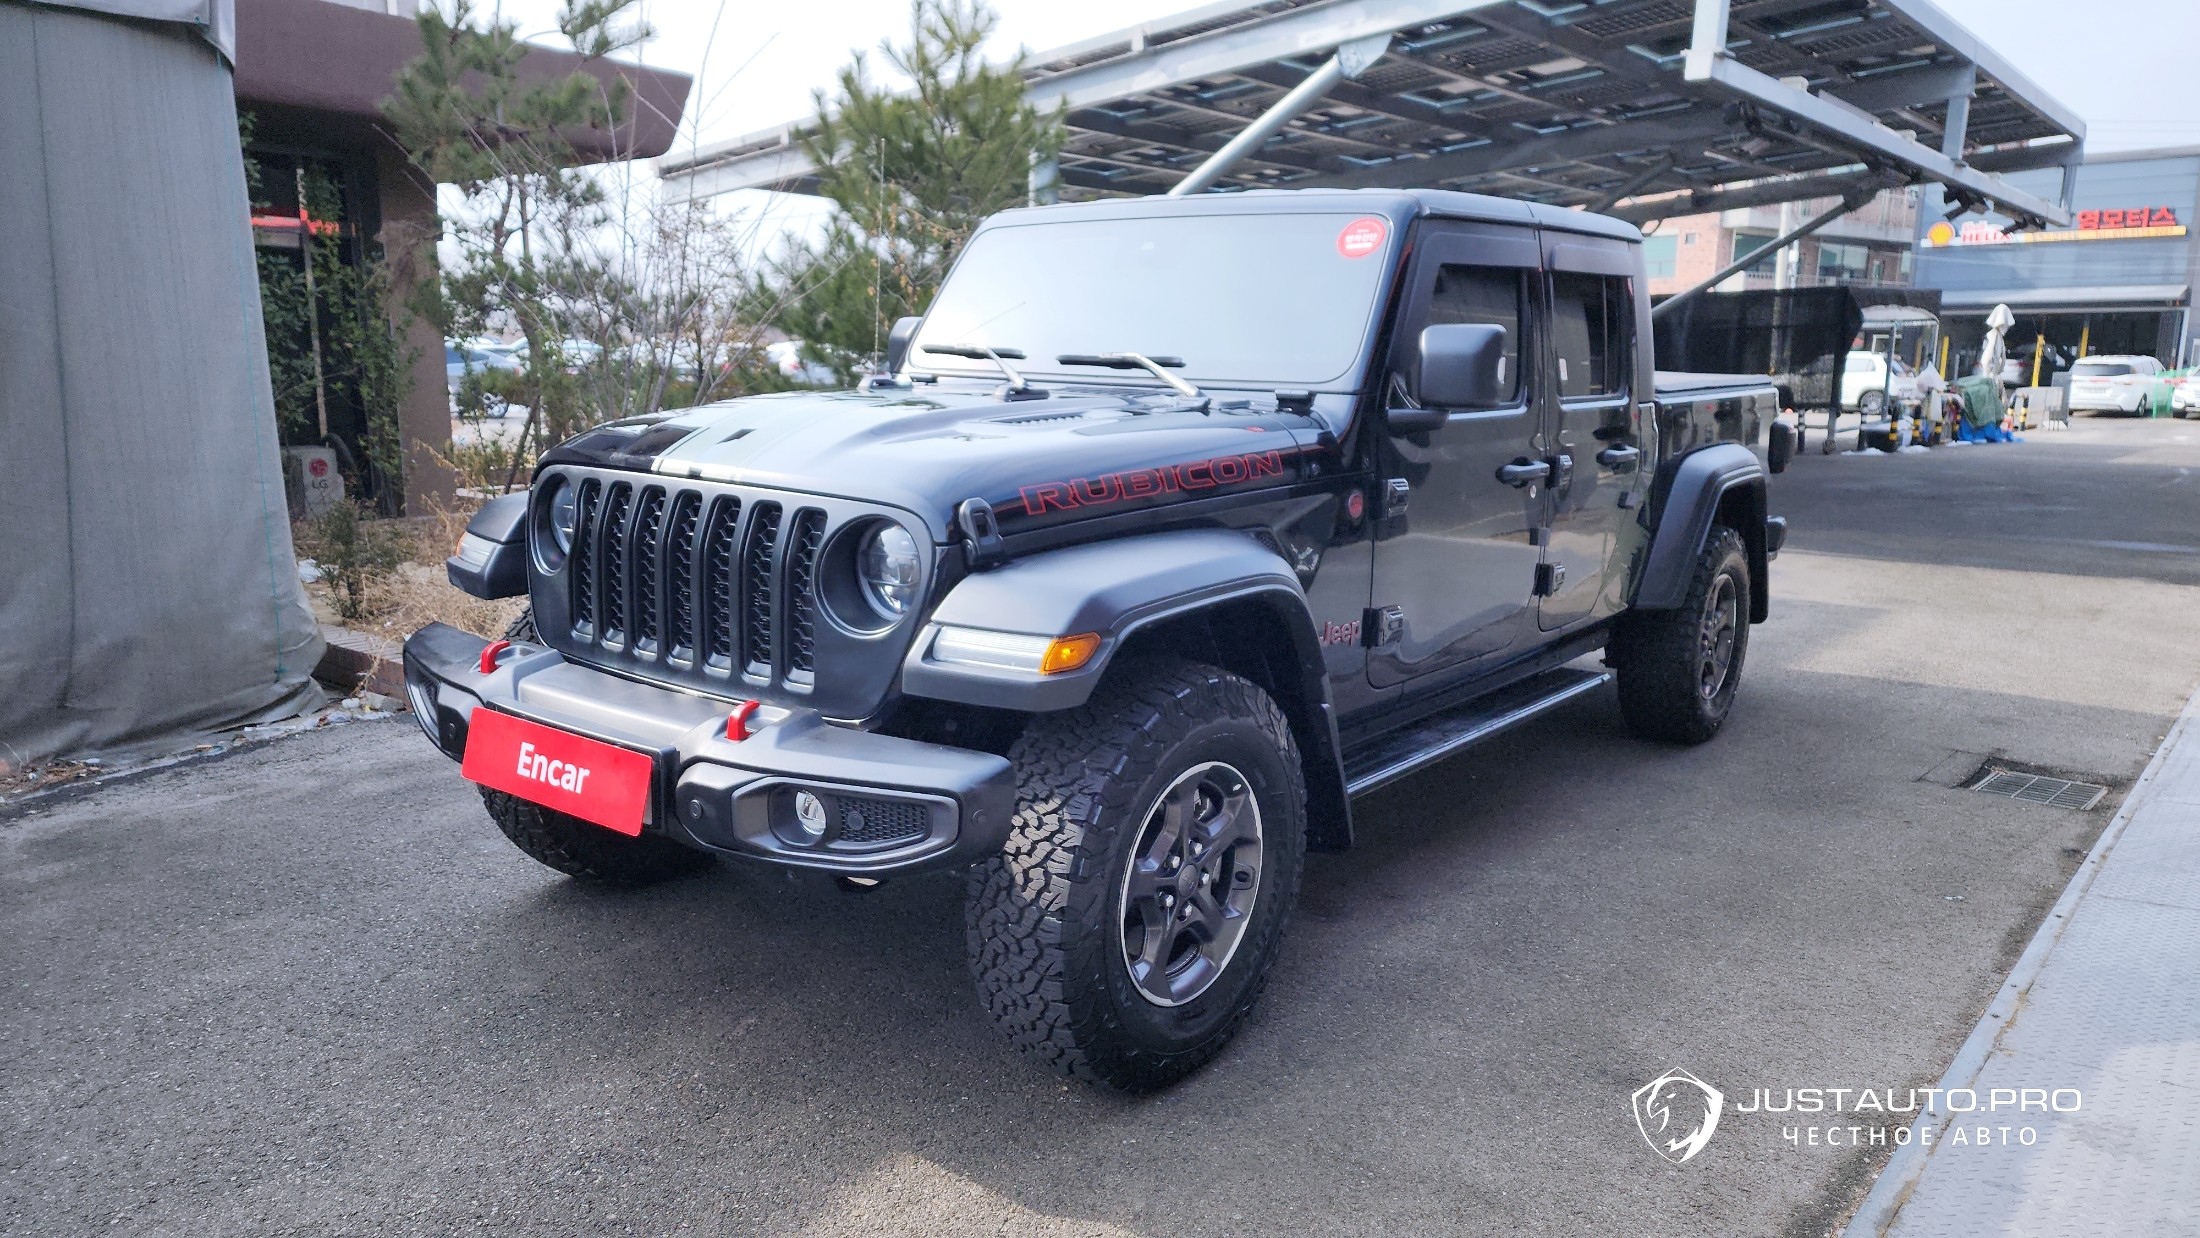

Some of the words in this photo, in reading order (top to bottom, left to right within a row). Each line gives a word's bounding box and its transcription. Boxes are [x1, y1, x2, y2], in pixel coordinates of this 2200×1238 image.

[312, 479, 329, 489] LG
[1019, 450, 1284, 516] RUBICON
[1319, 620, 1361, 647] Jeep
[516, 741, 591, 795] Encar
